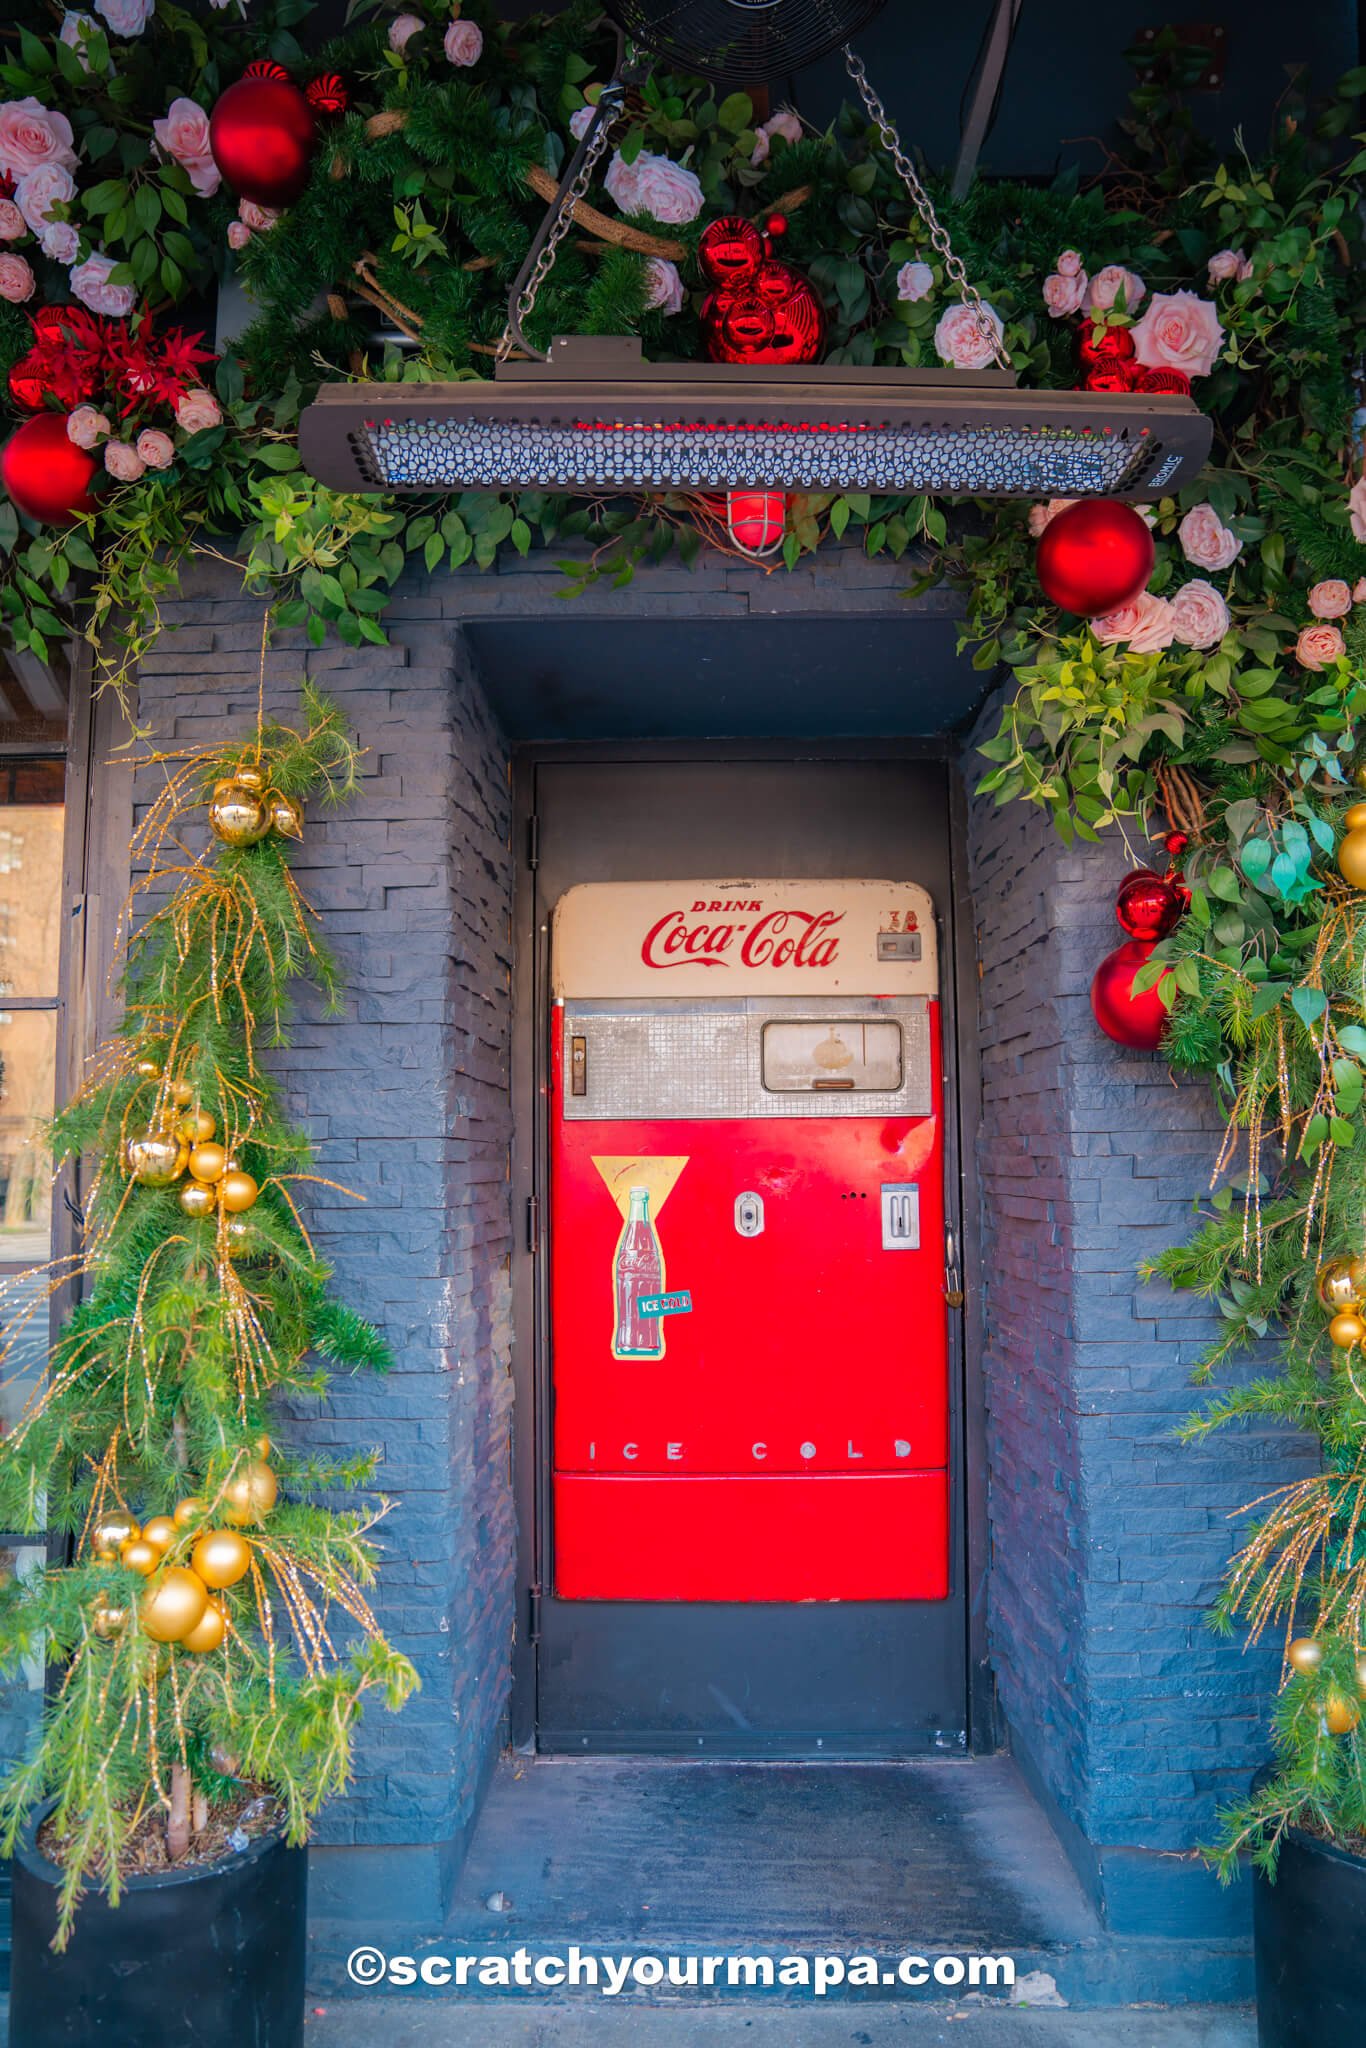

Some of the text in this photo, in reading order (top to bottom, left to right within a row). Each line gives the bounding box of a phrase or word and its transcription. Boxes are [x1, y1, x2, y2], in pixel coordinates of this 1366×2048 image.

[1148, 454, 1179, 487] BROMIC
[690, 900, 764, 912] DRINK
[641, 910, 847, 969] Coca-Cola
[641, 1296, 689, 1312] ICE COLD
[589, 1440, 911, 1460] ICE COLD
